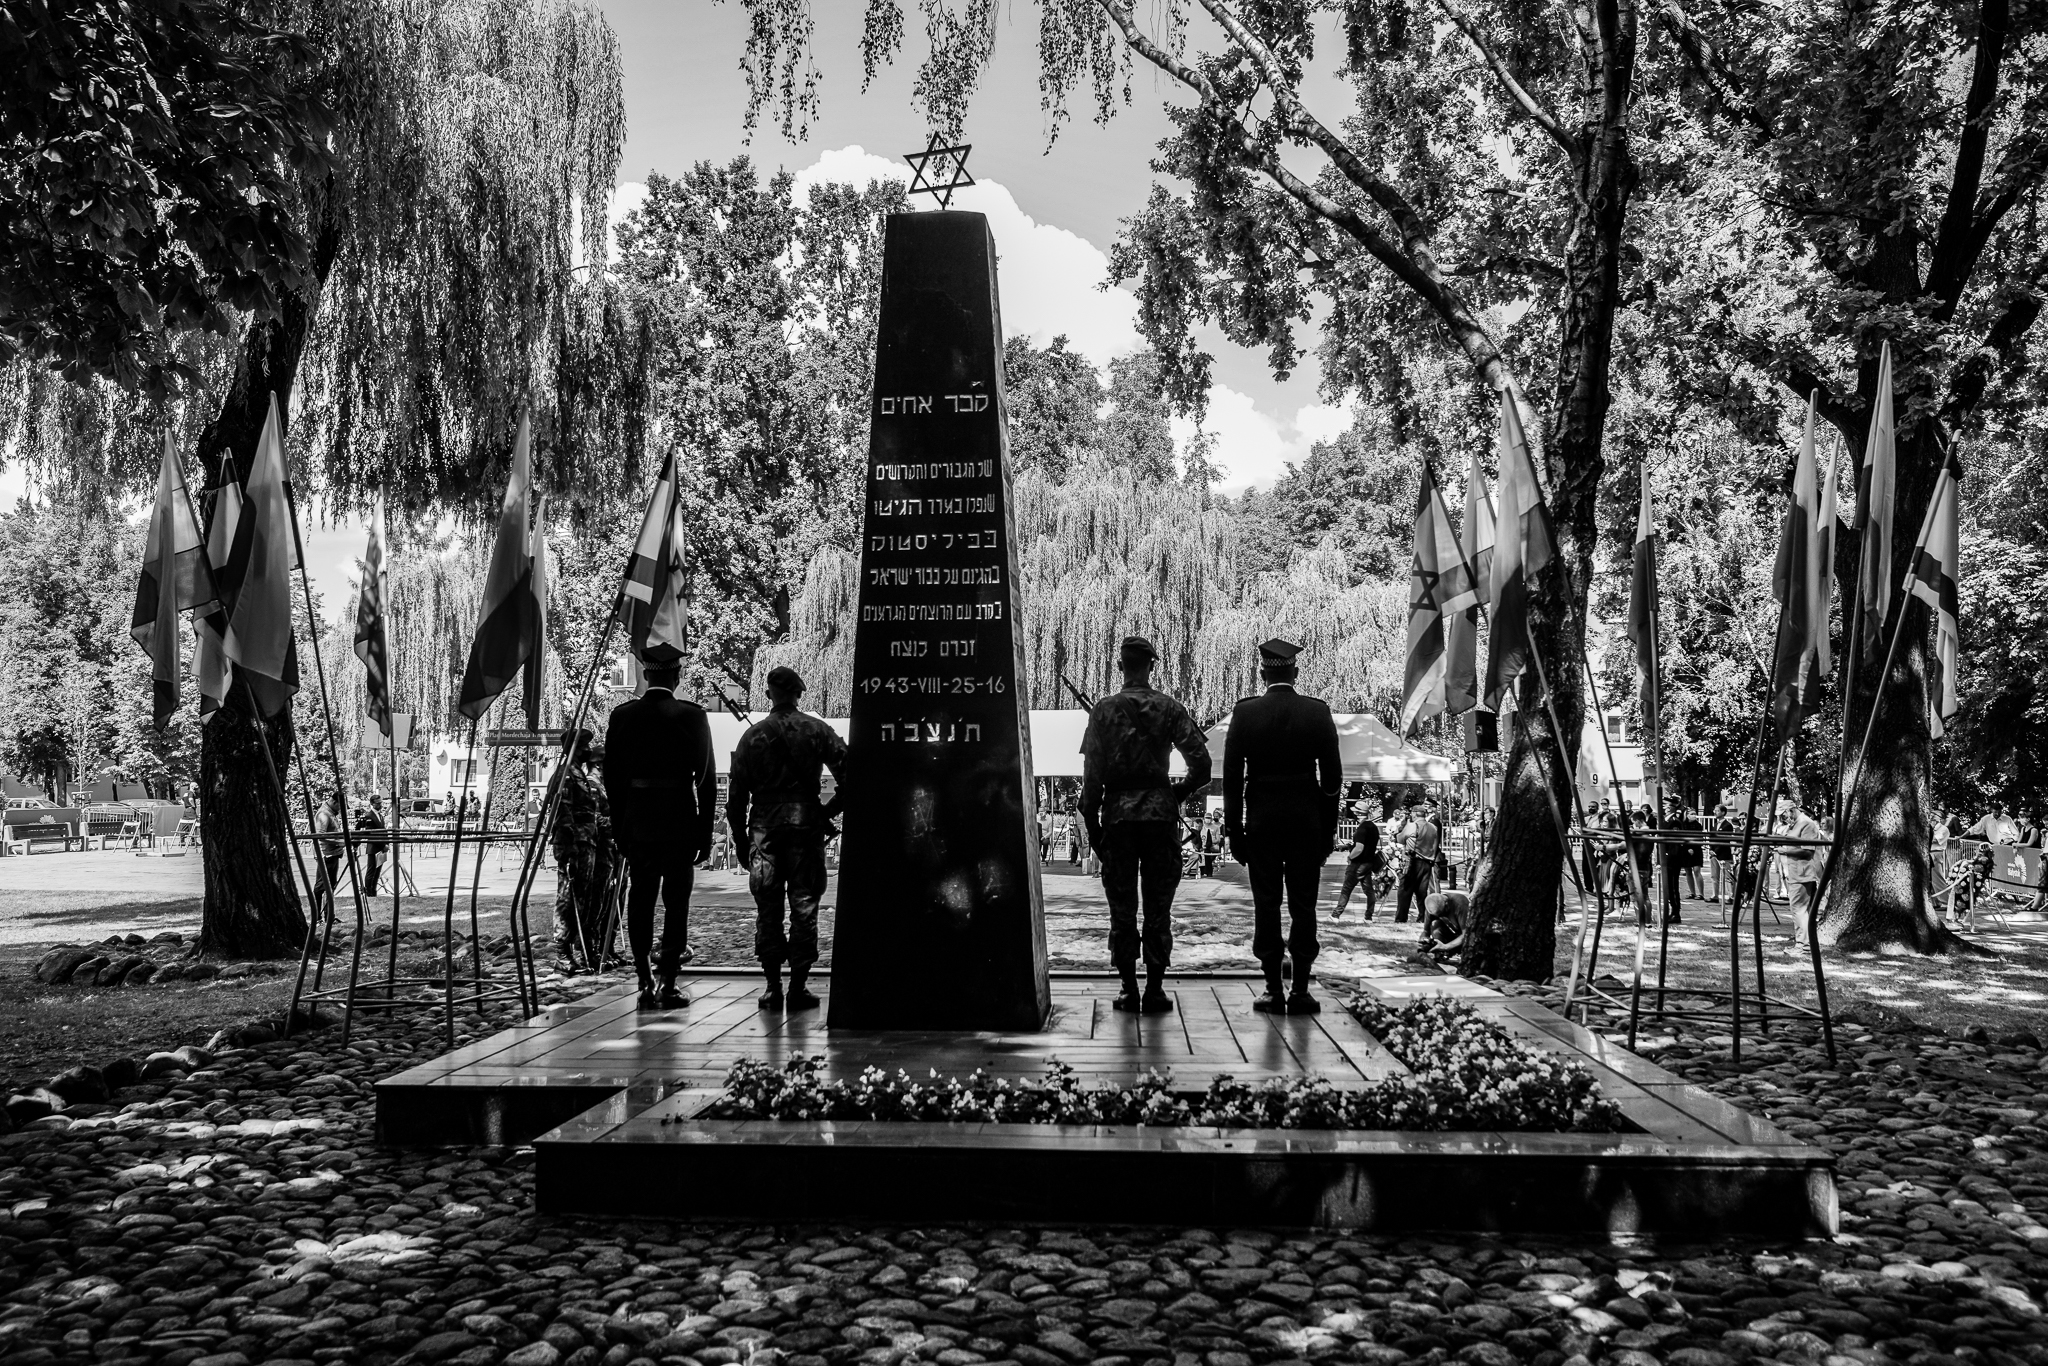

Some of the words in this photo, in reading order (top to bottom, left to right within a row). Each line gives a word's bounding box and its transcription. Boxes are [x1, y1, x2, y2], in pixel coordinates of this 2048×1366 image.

[882, 396, 932, 414] אחים
[945, 394, 988, 412] קבר
[1592, 773, 1598, 785] 9
